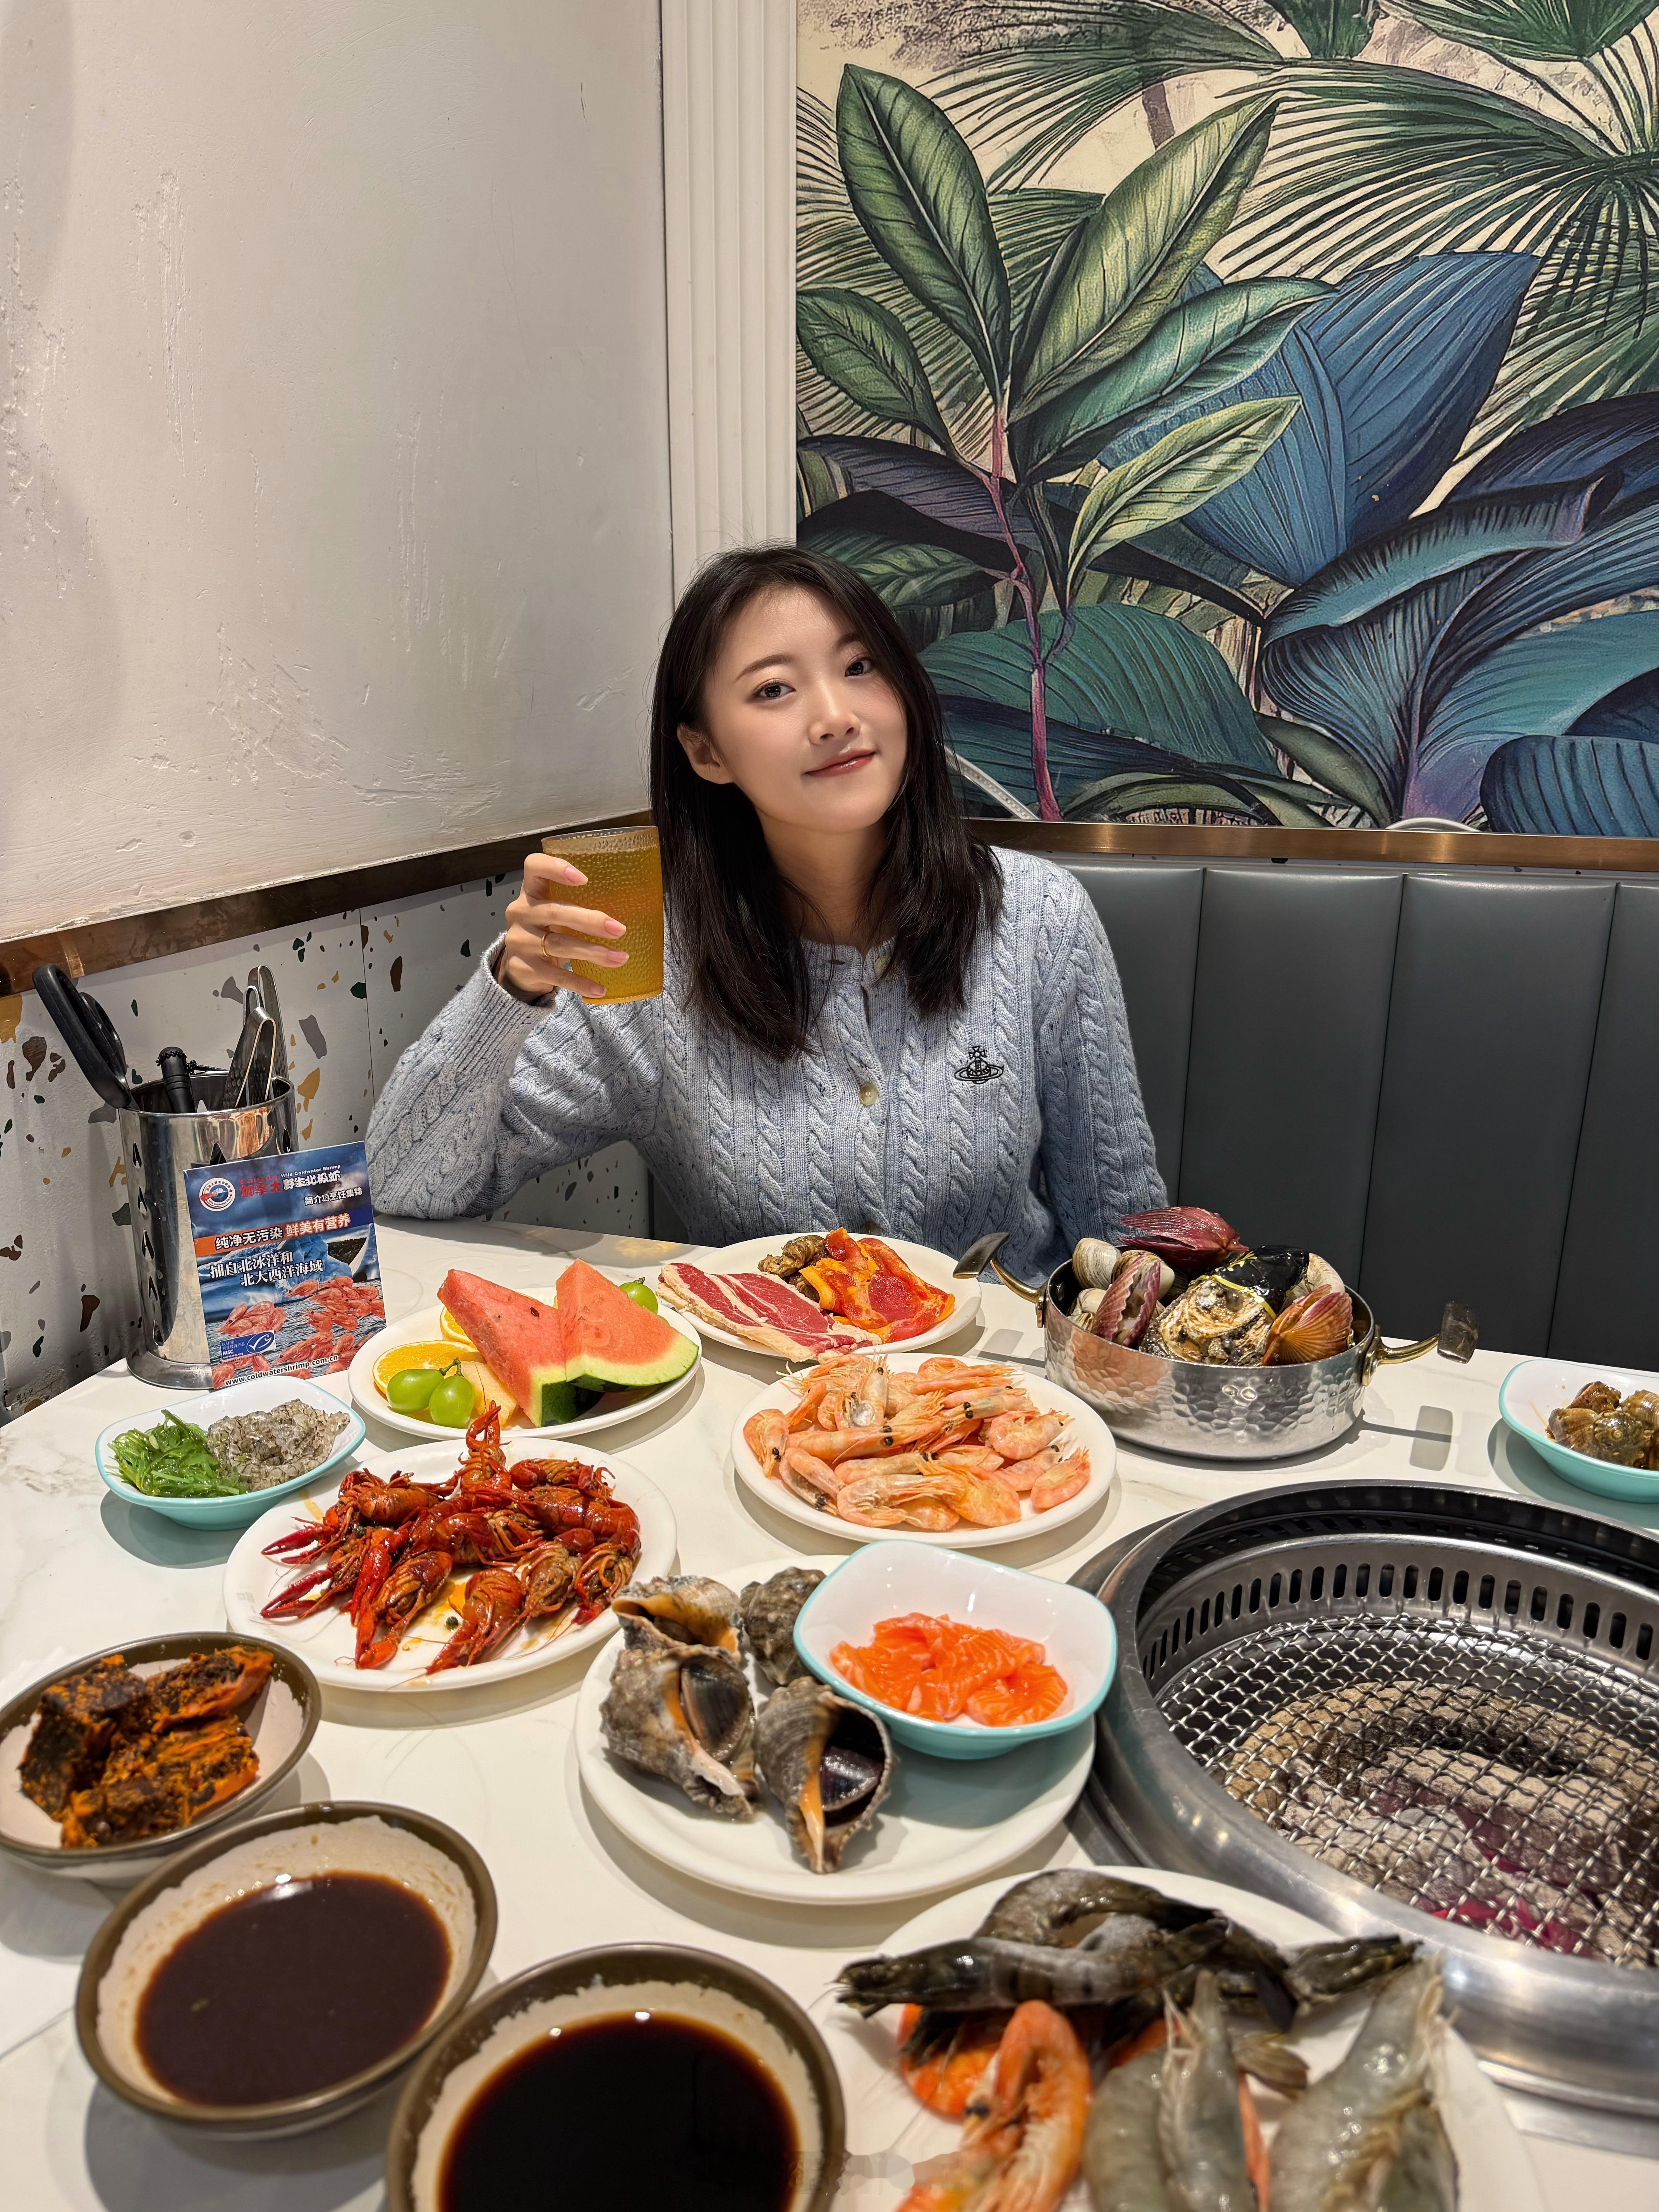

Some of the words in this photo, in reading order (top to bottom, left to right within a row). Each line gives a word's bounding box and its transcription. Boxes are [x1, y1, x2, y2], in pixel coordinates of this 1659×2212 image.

[283, 1170, 341, 1190] 野生北极虾
[294, 1168, 321, 1176] Coldwater
[304, 1187, 362, 1206] 简介及烹饪集锦
[215, 1226, 283, 1250] 纯净无污染
[286, 1213, 350, 1237] 鲜美有营养
[210, 1251, 293, 1278] 捕自北冰洋和
[241, 1260, 323, 1287] 北大西洋海域
[225, 1355, 338, 1386] www.coldwatershrimp.com.cn
